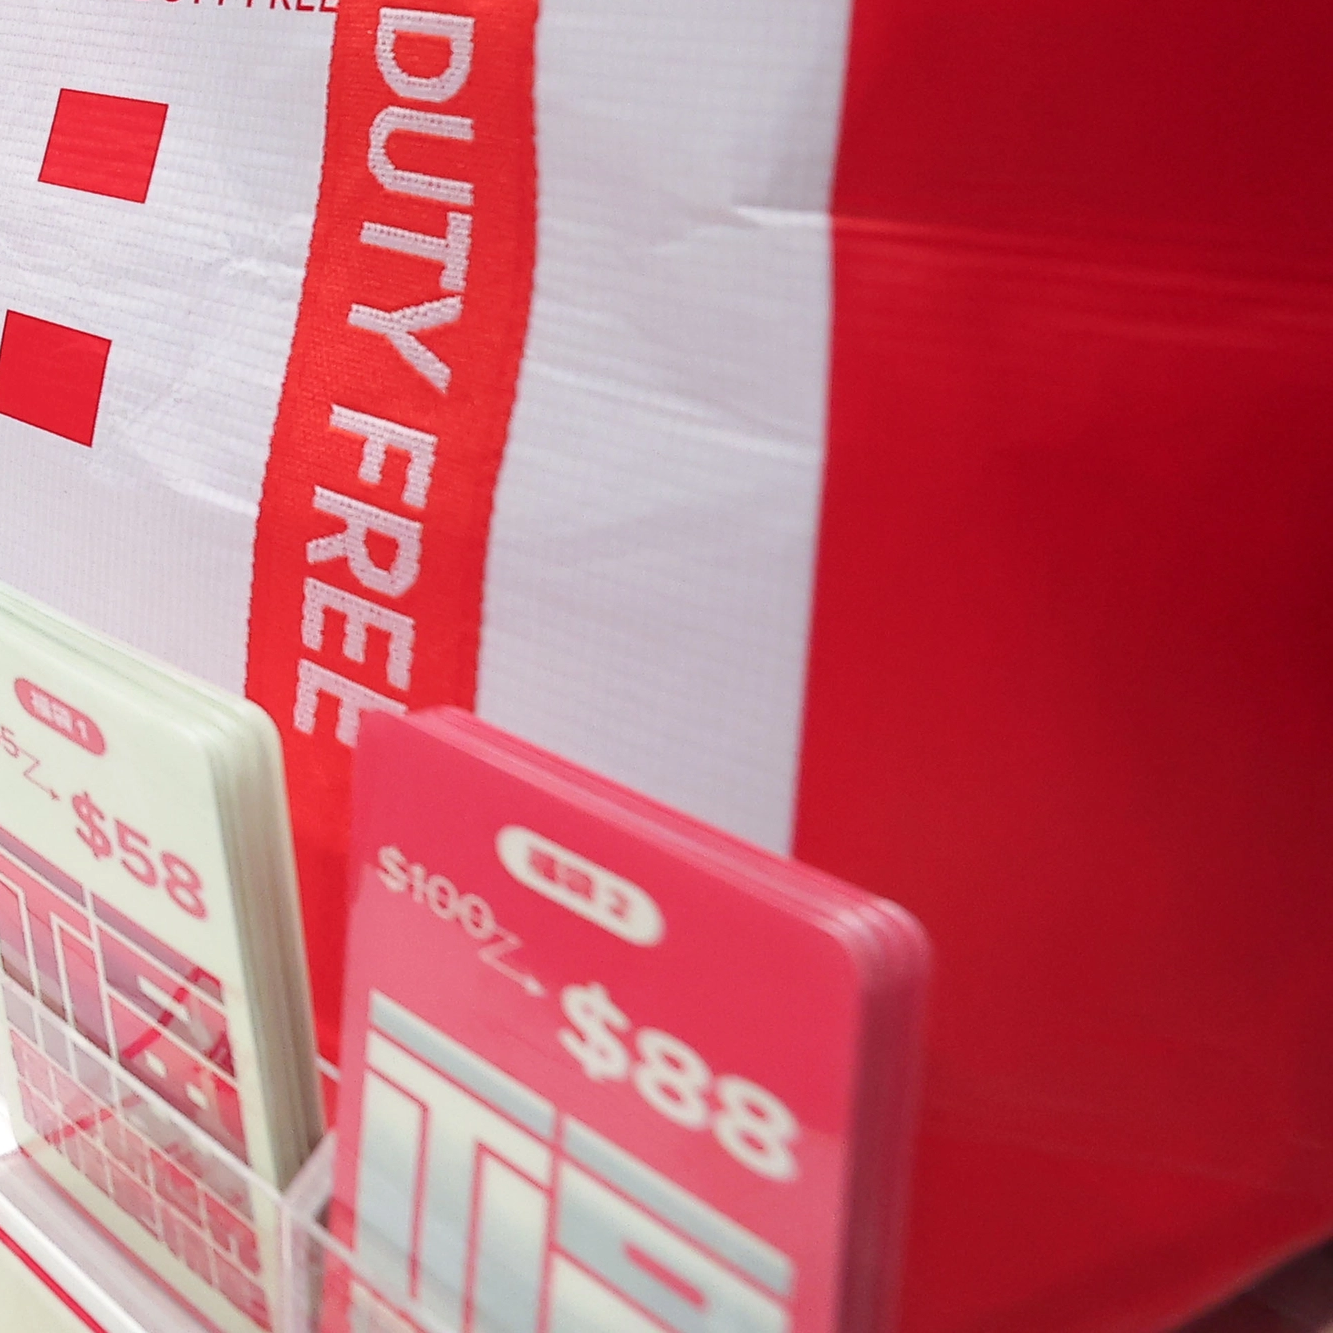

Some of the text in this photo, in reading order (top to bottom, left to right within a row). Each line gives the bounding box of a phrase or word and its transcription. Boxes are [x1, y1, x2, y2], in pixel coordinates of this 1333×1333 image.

[347, 6, 475, 393] DUTY
[293, 403, 438, 747] FREE
[71, 790, 210, 922] $58
[376, 844, 497, 940] $100
[556, 980, 799, 1184] $88
